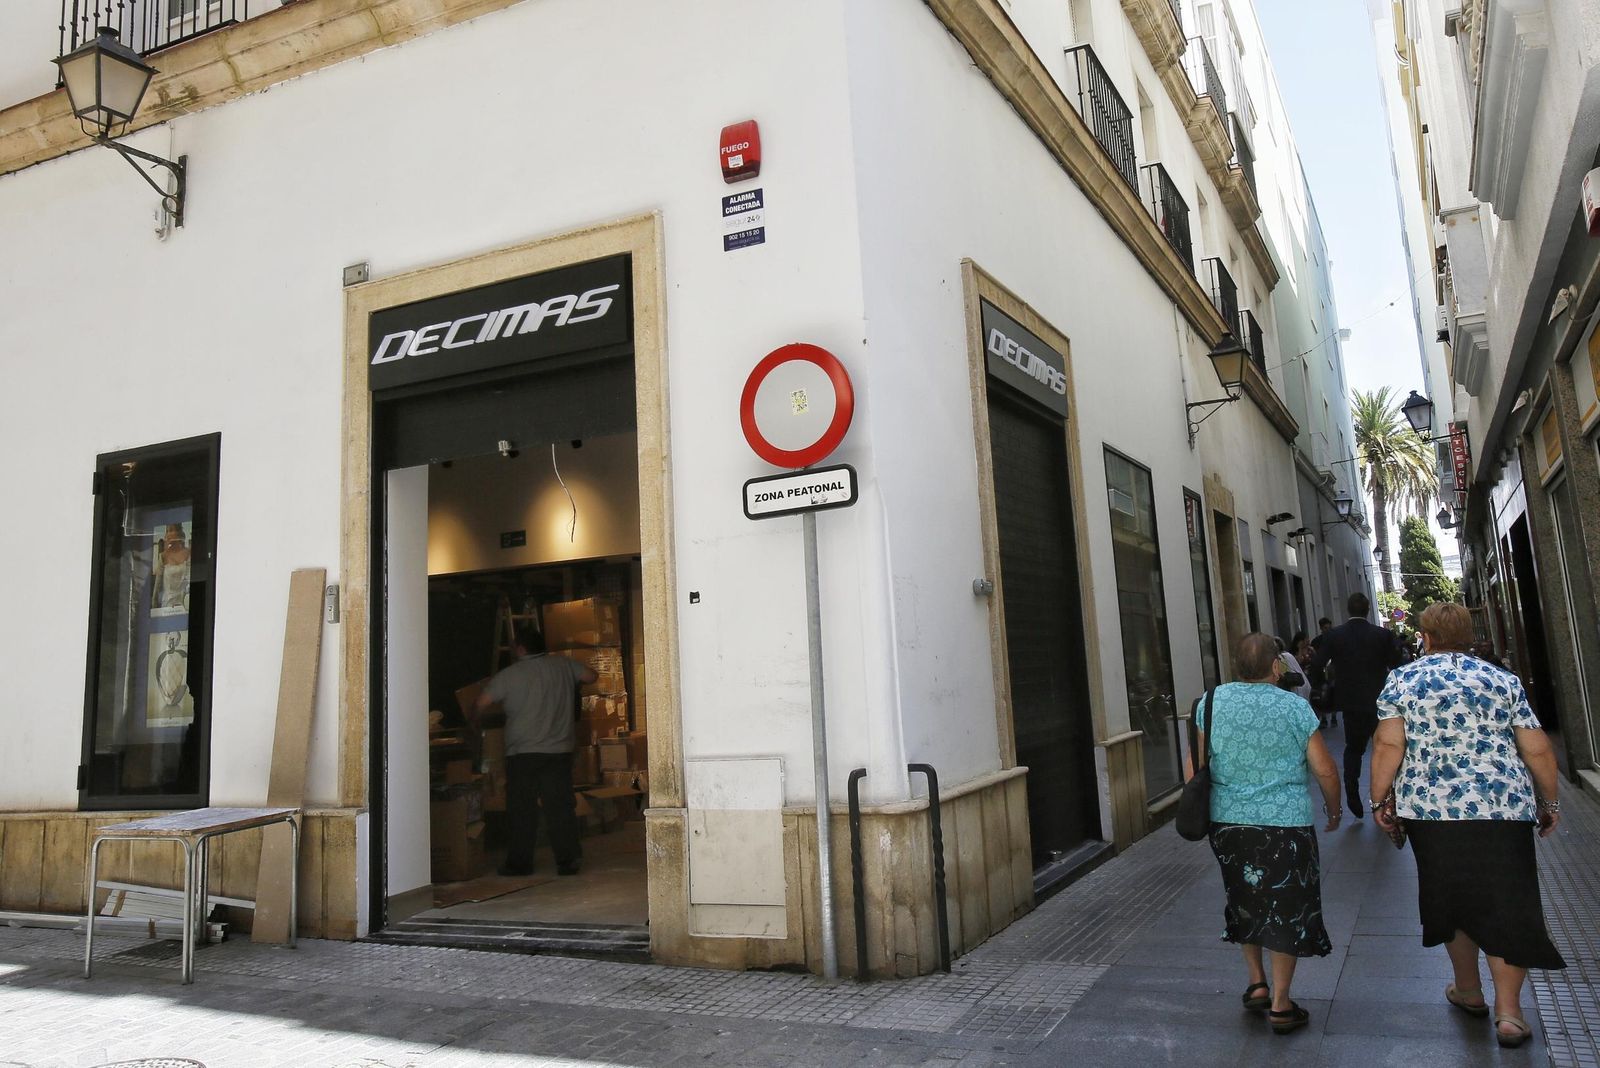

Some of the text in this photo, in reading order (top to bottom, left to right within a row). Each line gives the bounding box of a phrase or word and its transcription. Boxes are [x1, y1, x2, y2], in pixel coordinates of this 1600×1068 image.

[721, 141, 749, 155] FUEGO
[729, 192, 756, 205] ALARMA
[725, 200, 761, 214] CONECTADA
[728, 233, 738, 241] 902
[370, 283, 620, 365] DECIMAS
[988, 328, 1067, 395] DECIMAS
[754, 481, 845, 503] ZONA PEATONAL
